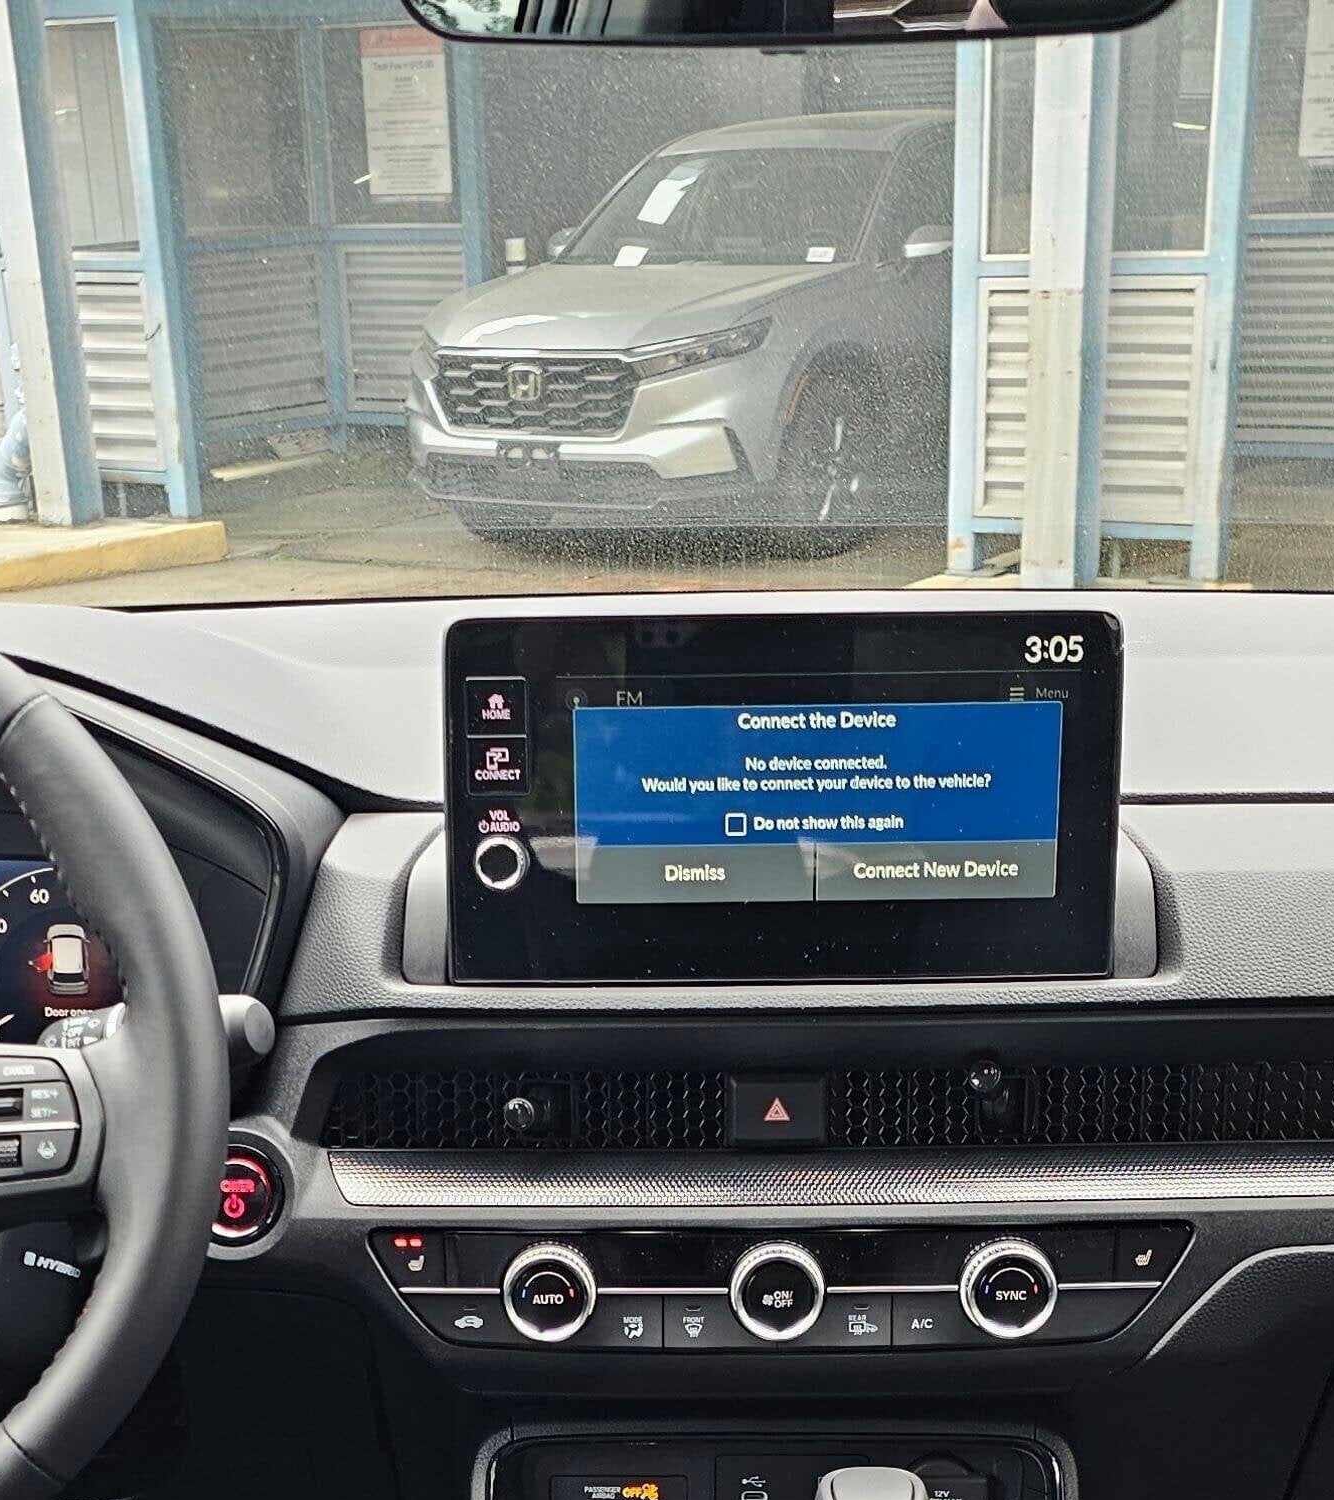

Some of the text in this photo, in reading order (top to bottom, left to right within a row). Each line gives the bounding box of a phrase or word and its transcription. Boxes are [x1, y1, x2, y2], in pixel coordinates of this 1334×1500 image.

[1024, 635, 1084, 663] 3:05
[617, 691, 643, 706] FM
[1035, 687, 1069, 699] Menu
[481, 708, 511, 720] HOME
[737, 711, 897, 730] Connect the Device
[745, 754, 888, 772] No device connected.
[474, 769, 521, 781] CONNECT
[642, 773, 992, 795] Would you like to connect your device to the vehicle?
[489, 810, 510, 821] VOL
[490, 821, 521, 833] AUDIO
[754, 815, 904, 831] Do not show this again
[665, 864, 725, 882] Dismiss
[853, 860, 1019, 879] Connect New Device
[29, 889, 49, 904] 60
[44, 1007, 68, 1017] Door
[533, 1294, 564, 1305] AUTO
[774, 1290, 793, 1300] ON/
[995, 1290, 1027, 1301] SYNC
[774, 1299, 793, 1309] OFF
[623, 1316, 643, 1324] MODE
[682, 1316, 704, 1324] FRONT
[911, 1318, 933, 1330] A/C
[934, 1490, 950, 1498] 12V
